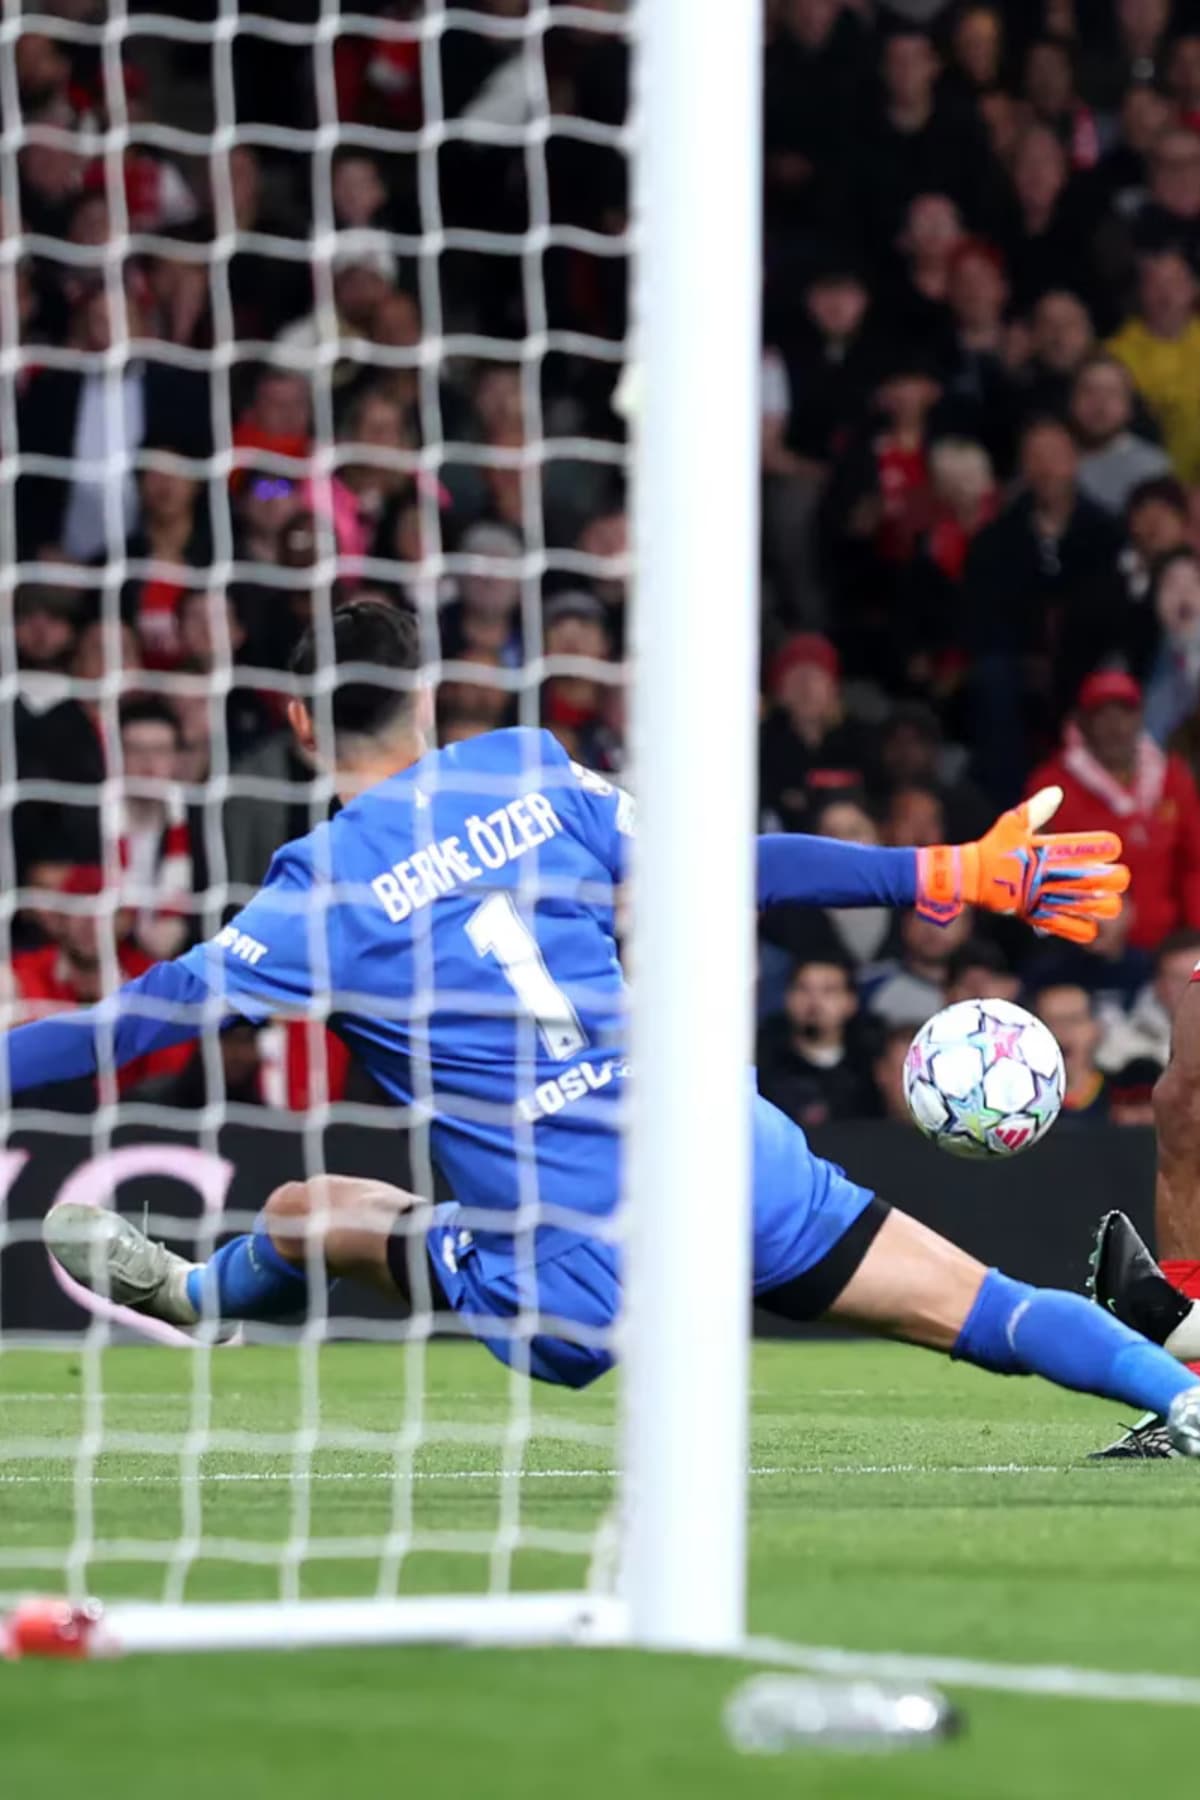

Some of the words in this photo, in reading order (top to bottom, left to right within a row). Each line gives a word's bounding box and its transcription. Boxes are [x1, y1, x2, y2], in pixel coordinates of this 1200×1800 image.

[371, 835, 483, 923] BERKE
[465, 792, 563, 869] ÖZER
[464, 889, 590, 1061] 1
